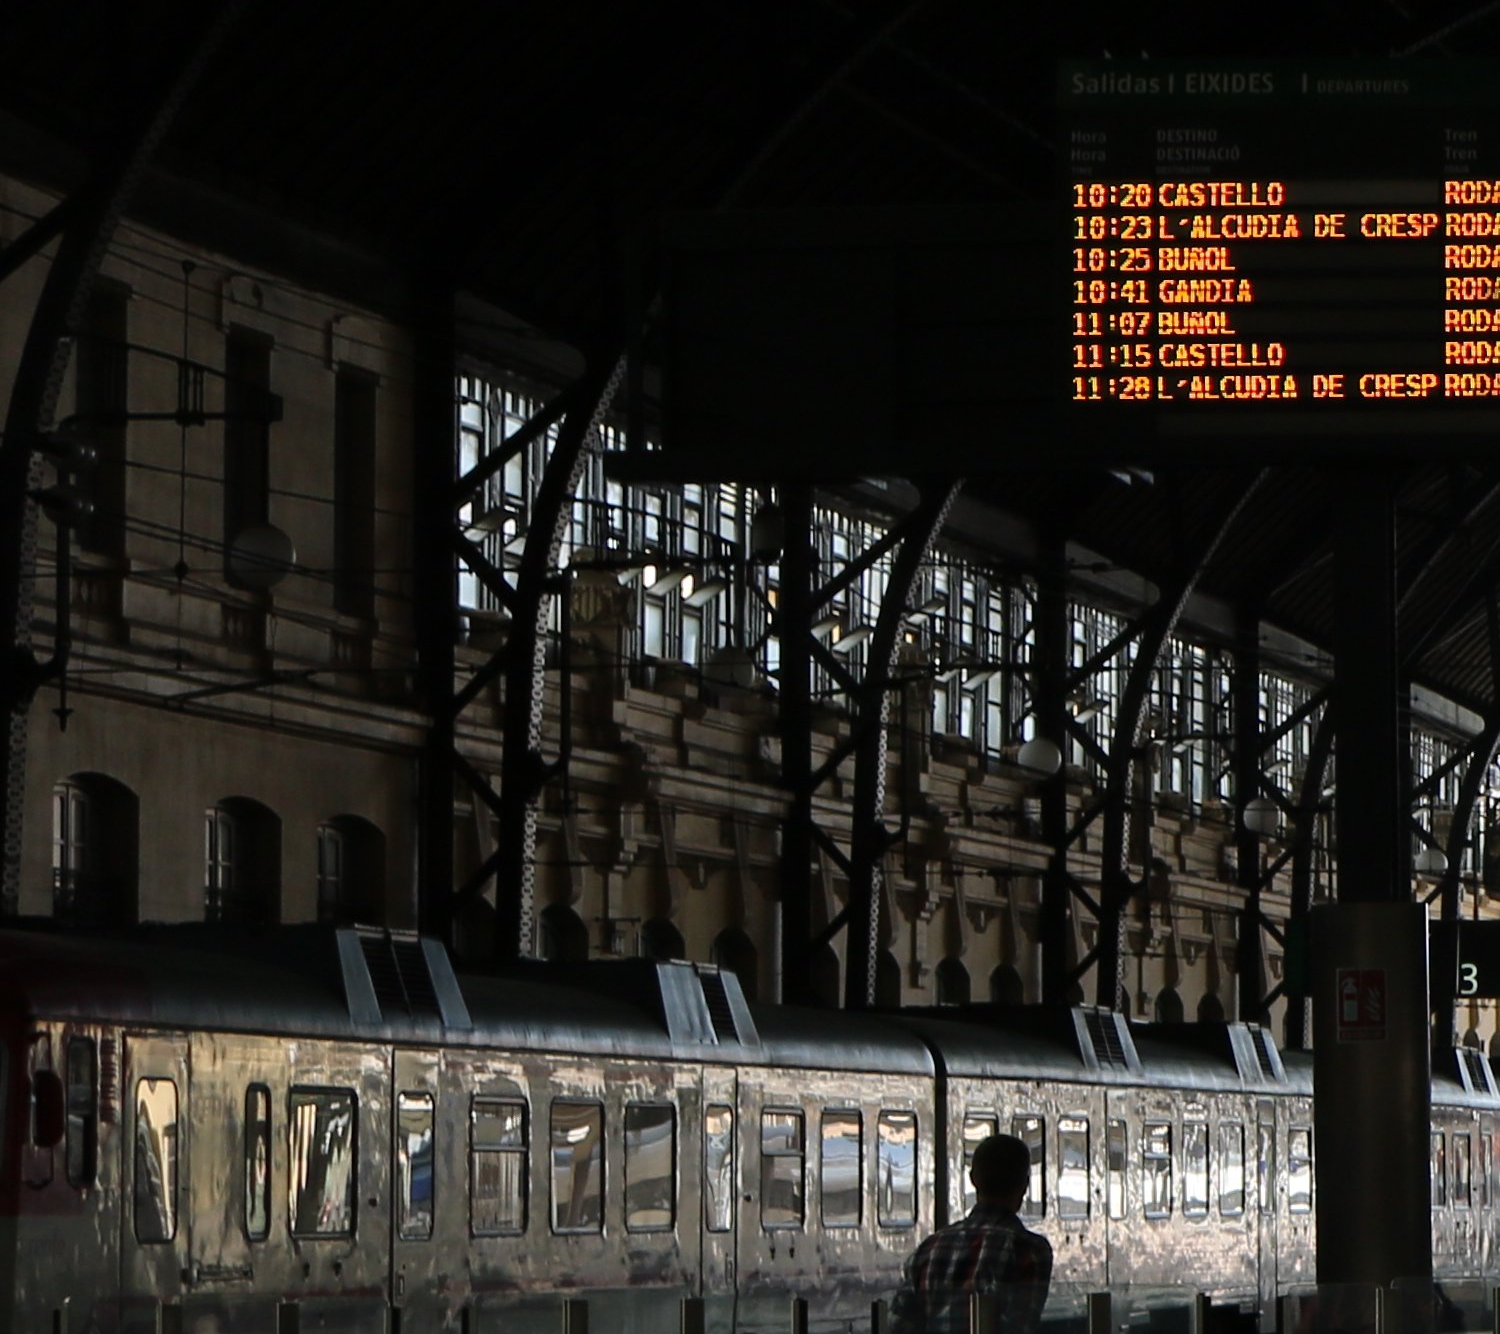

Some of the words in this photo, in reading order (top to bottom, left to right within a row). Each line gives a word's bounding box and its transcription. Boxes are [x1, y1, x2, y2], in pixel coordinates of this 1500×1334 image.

[1072, 73, 1160, 94] Salidas
[1185, 73, 1273, 94] EIXIDES
[1317, 79, 1409, 93] DEPARTURES
[1157, 129, 1217, 143] DESTINO
[1073, 183, 1155, 209] 10:20
[1158, 181, 1287, 208] CASTELLO
[1073, 215, 1155, 241] 10:23
[1314, 213, 1347, 238] DE
[1360, 212, 1442, 239] CRESP
[1072, 247, 1155, 273] 10:25
[1158, 246, 1236, 272] BUÑOL
[1073, 279, 1151, 305] 10:41
[1158, 278, 1255, 305] GANDIA
[1072, 311, 1154, 337] 11:07
[1157, 310, 1236, 337] BUÑOL
[1072, 343, 1155, 369] 11:15
[1158, 342, 1287, 368] CASTELLO
[1072, 375, 1154, 401] 11:28
[1312, 374, 1345, 399] DE
[1359, 373, 1441, 399] CRESP
[1459, 962, 1479, 995] 3
